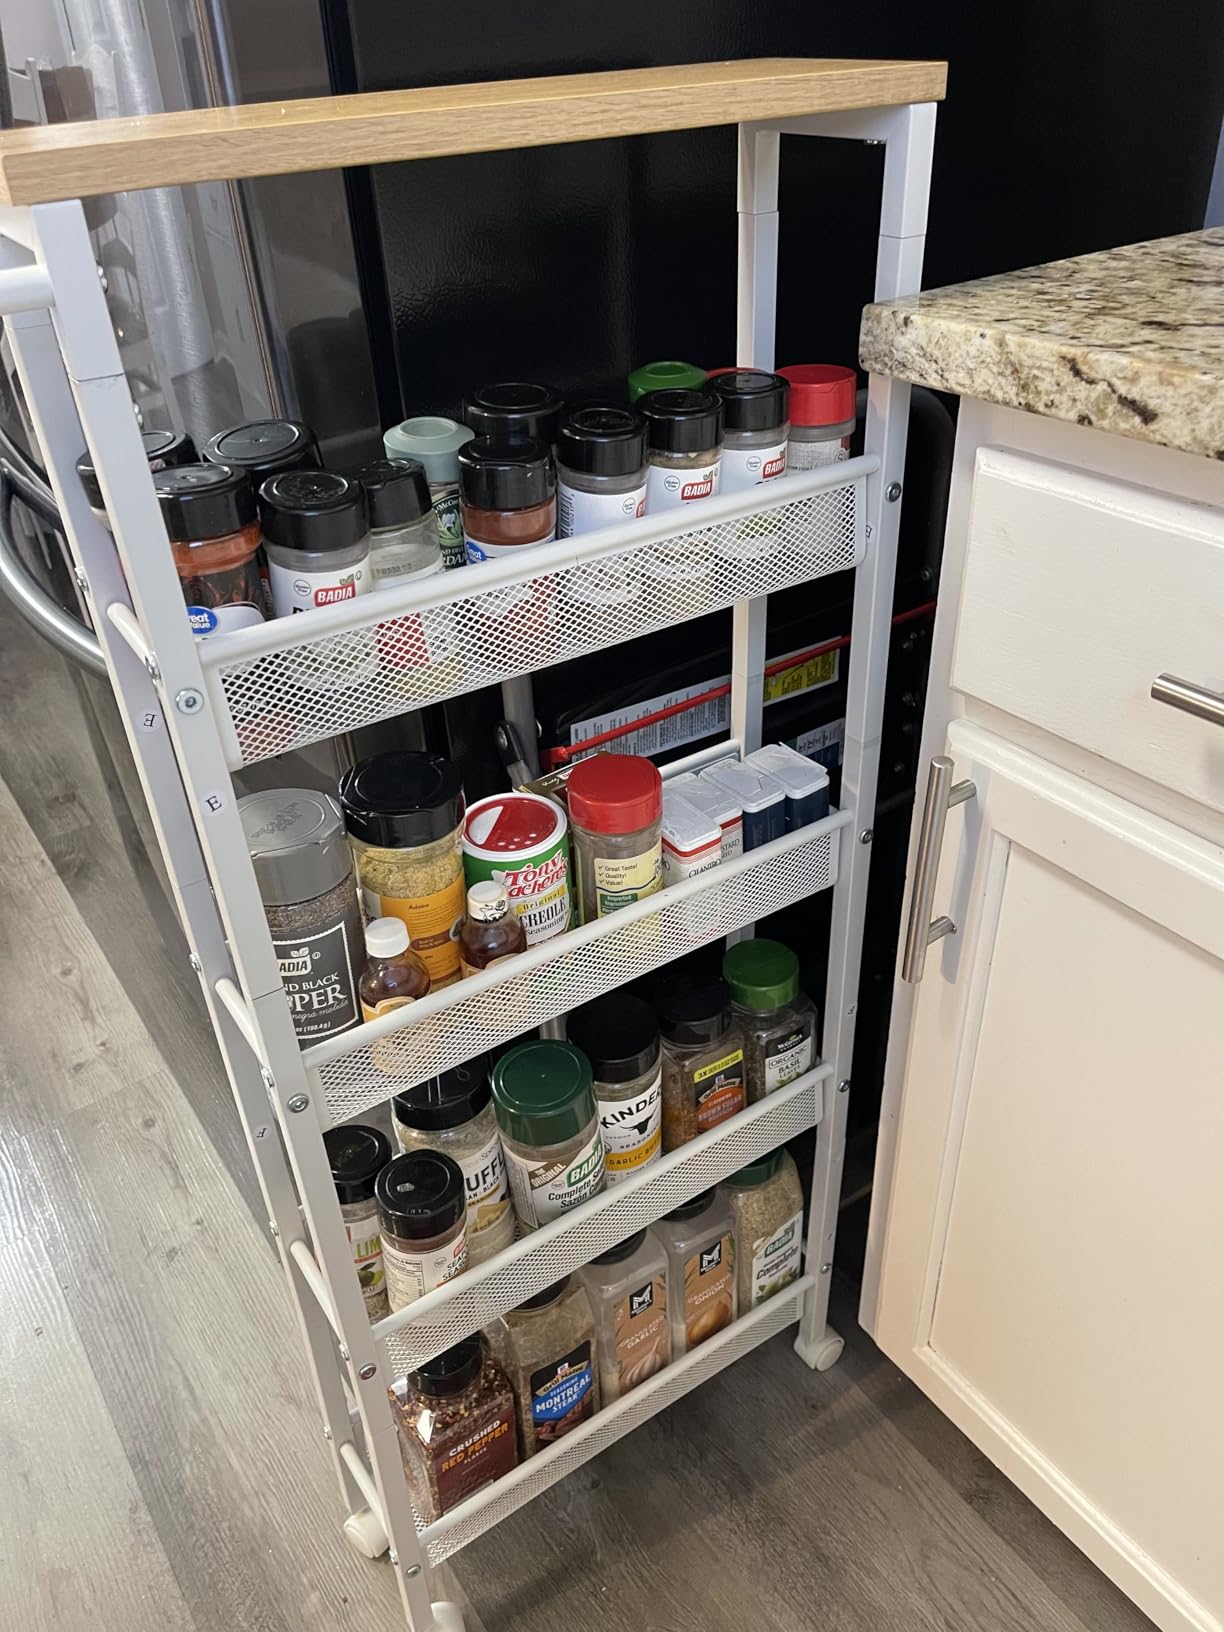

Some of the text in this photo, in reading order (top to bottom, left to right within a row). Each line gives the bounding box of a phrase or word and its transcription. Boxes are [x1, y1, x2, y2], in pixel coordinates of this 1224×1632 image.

[684, 482, 711, 496] BADIA
[317, 586, 353, 603] BADIA
[189, 613, 210, 623] reat
[205, 795, 222, 812] E
[505, 851, 561, 886] Tony
[523, 889, 560, 910] Original
[520, 897, 566, 928] CREOLE
[280, 960, 308, 973] ADIA
[302, 972, 340, 991] BLACK
[293, 984, 348, 1012] PER
[770, 1045, 806, 1067] ORGANIC
[778, 1060, 801, 1074] BASIL
[609, 1154, 643, 1165] GARLIC
[465, 1152, 504, 1192] UFFL
[530, 1162, 567, 1189] ORIGINAL
[548, 1178, 592, 1202] Complete
[356, 1236, 382, 1258] LIM
[694, 1281, 725, 1305] ONION
[626, 1323, 658, 1349] GARLIC
[535, 1373, 592, 1413] MONTREAL
[552, 1394, 578, 1413] STEAK
[441, 1453, 465, 1472] RED
[467, 1422, 509, 1455] PEPPER
[449, 1420, 501, 1457] CRUSHED
